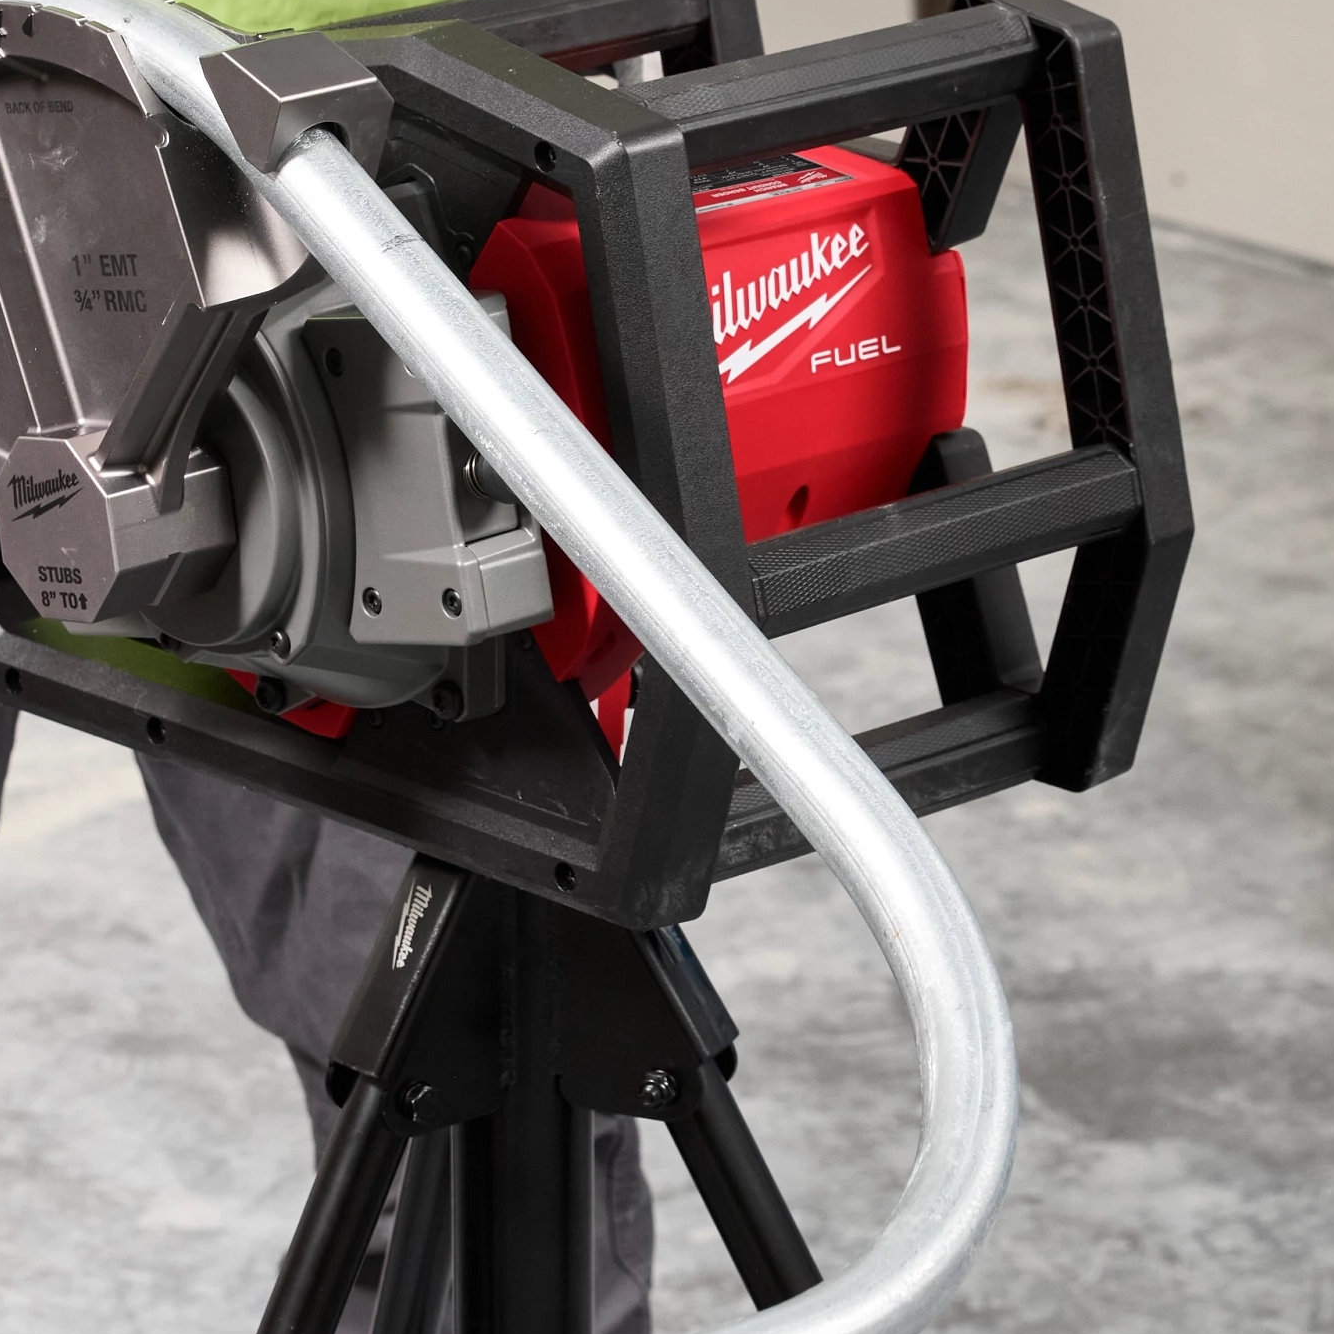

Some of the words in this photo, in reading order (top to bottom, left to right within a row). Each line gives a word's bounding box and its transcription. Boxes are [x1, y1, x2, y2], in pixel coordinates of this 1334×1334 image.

[5, 101, 32, 114] BACK
[33, 101, 46, 114] OF
[47, 100, 73, 113] BEND
[99, 253, 138, 277] EMT
[711, 223, 870, 346] ilwaukee
[103, 289, 148, 313] RMC
[810, 335, 902, 374] FUEL
[7, 468, 80, 510] Milwaukee
[37, 565, 83, 585] STUBS
[59, 592, 78, 609] TO
[396, 883, 433, 968] Milwaukee
